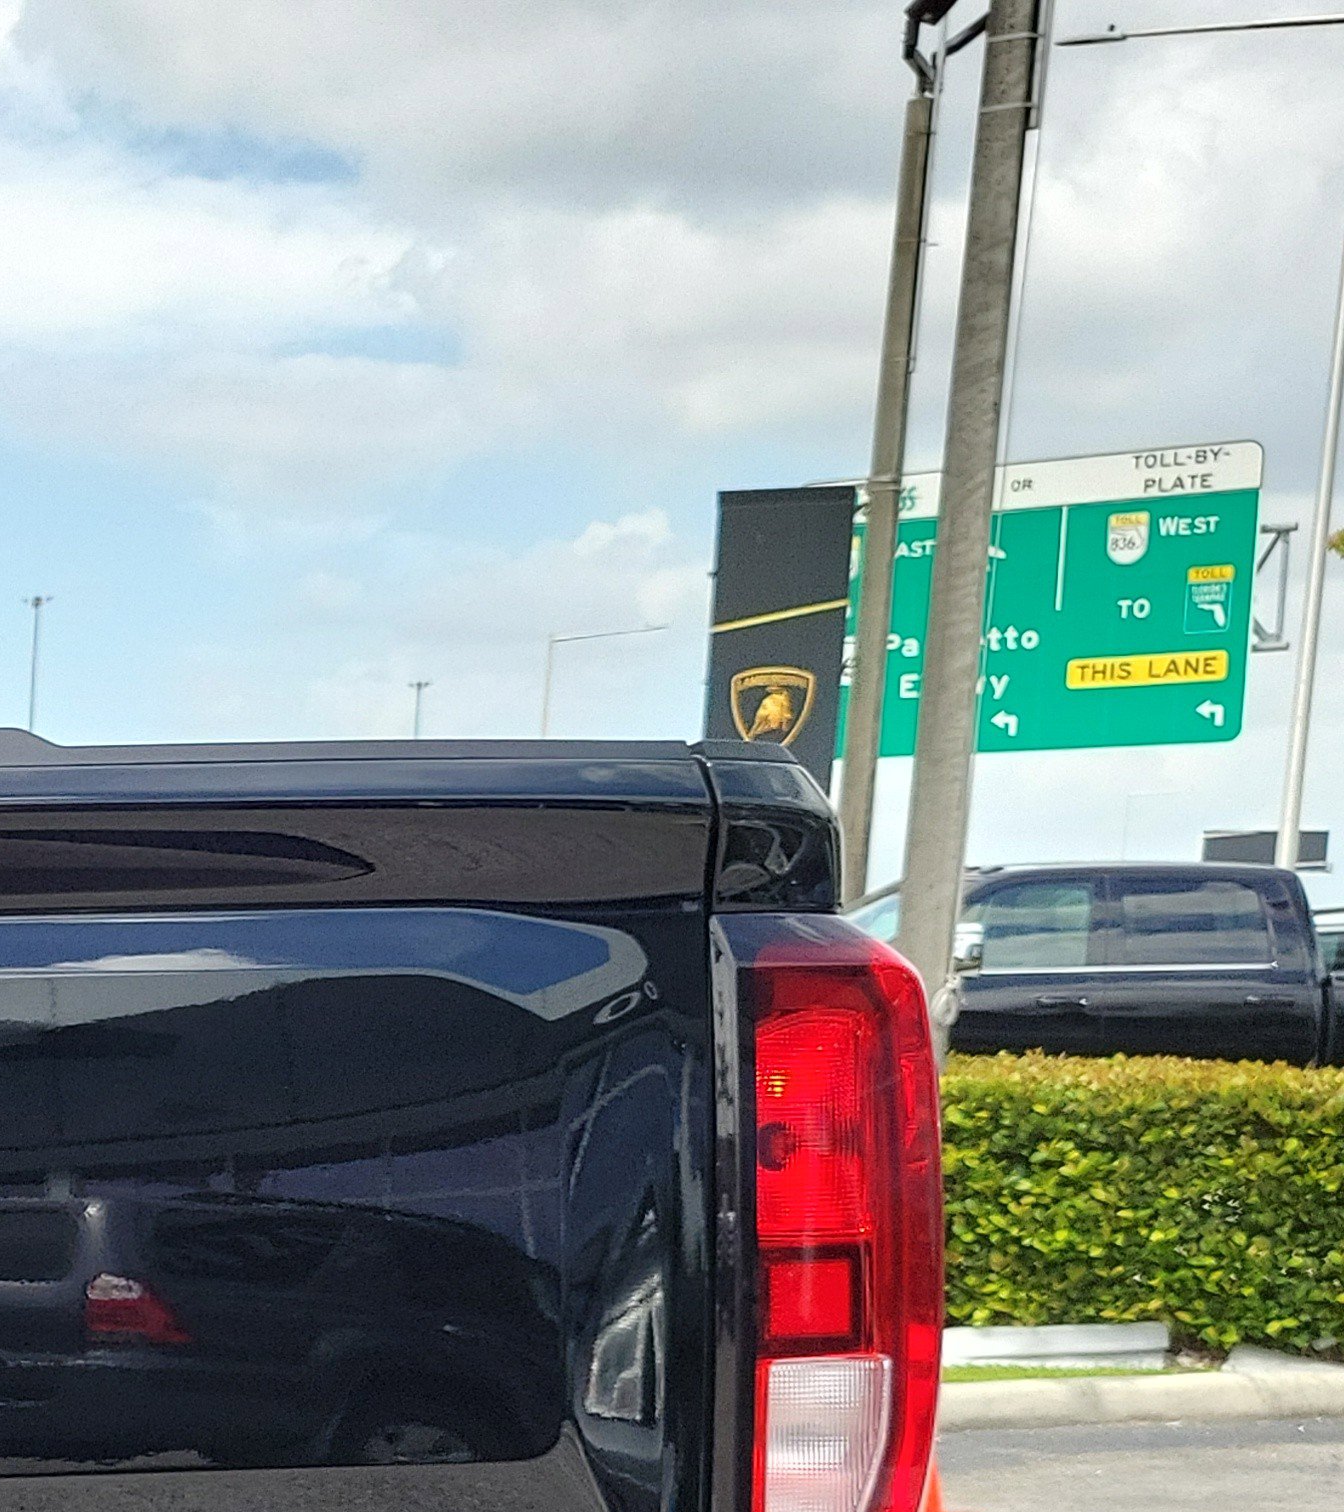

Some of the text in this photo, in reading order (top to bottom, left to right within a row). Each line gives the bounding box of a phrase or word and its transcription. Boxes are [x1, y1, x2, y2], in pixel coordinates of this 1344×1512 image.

[1133, 447, 1230, 470] TOLL-BY-
[1011, 479, 1033, 492] OR
[1144, 474, 1213, 493] PLATE
[1114, 515, 1143, 525] TOLL
[1159, 516, 1220, 537] WEST
[894, 538, 937, 558] AST
[1194, 567, 1228, 579] TOLL
[1117, 597, 1151, 619] TO
[1076, 656, 1218, 682] THIS LANE
